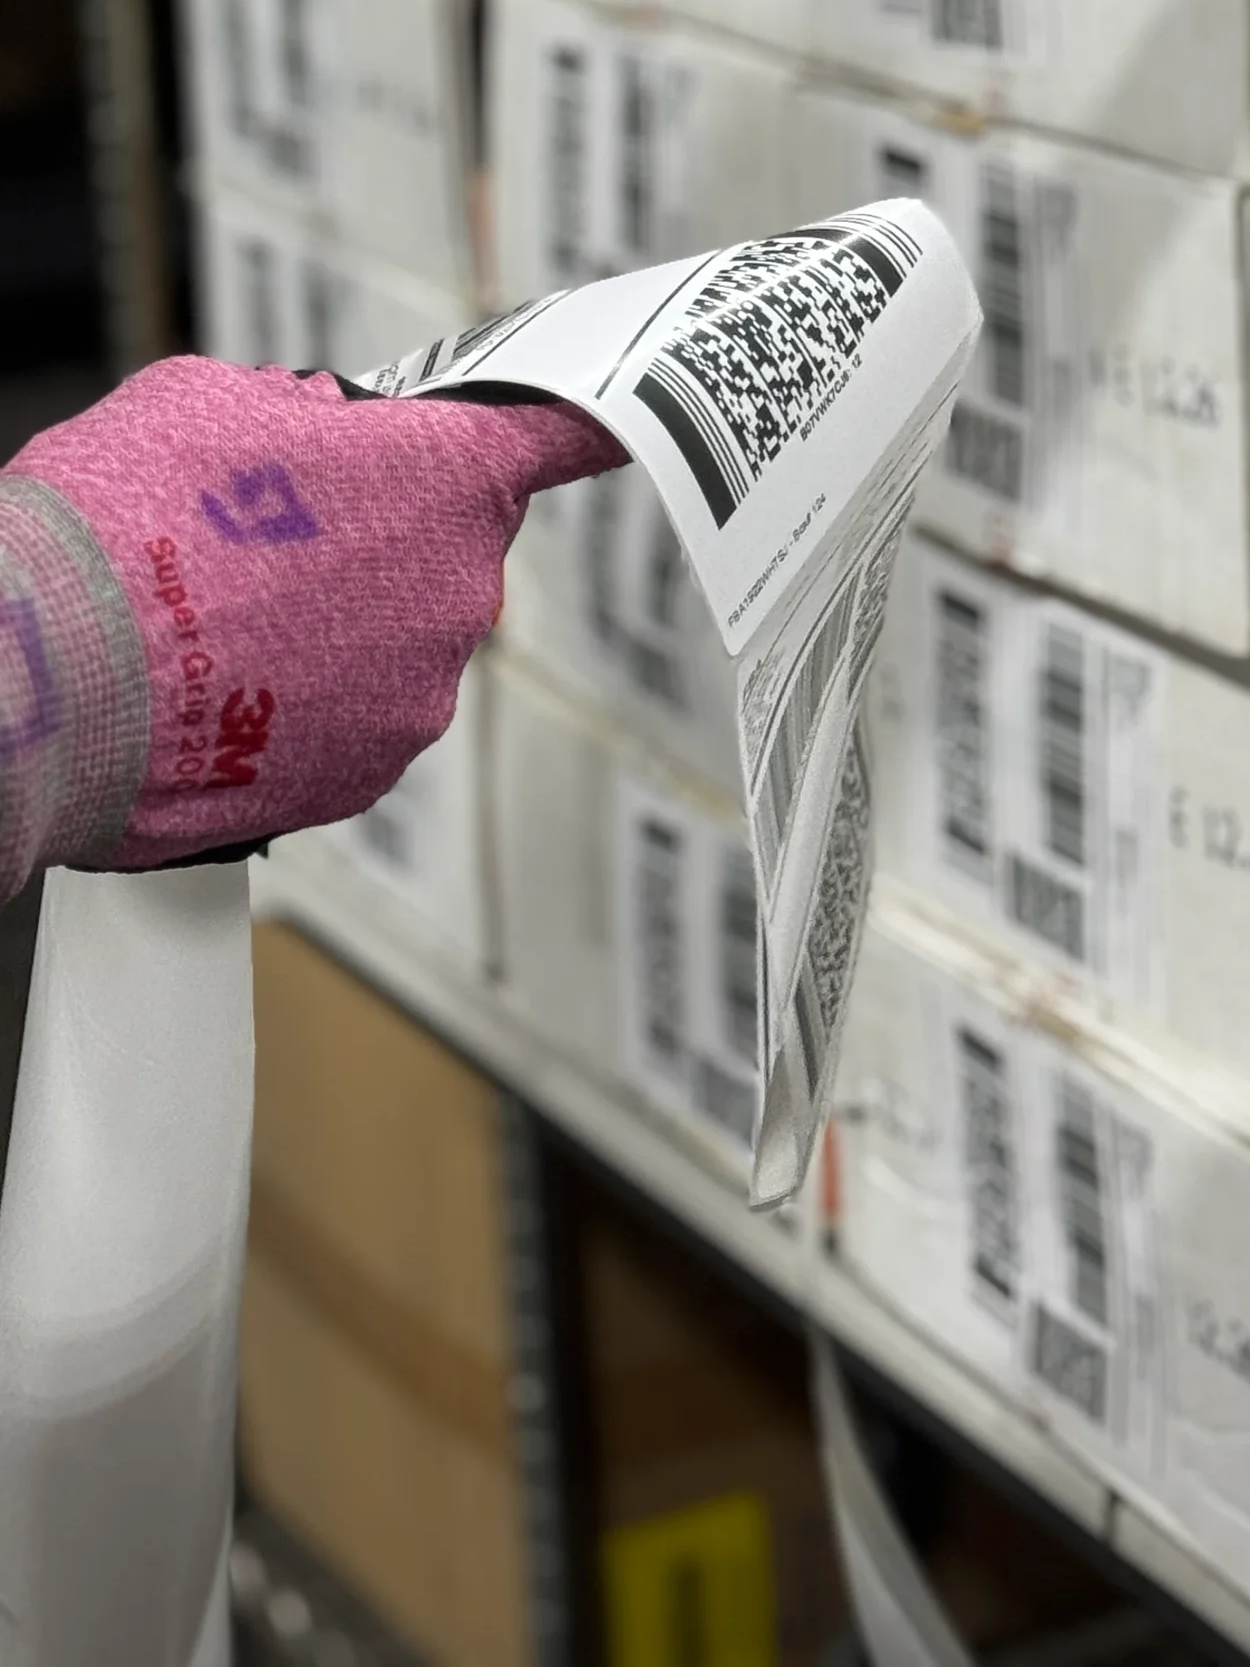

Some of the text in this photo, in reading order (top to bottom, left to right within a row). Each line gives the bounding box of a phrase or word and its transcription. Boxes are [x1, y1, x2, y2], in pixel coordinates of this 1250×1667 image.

[144, 536, 200, 639] Super
[180, 649, 215, 727] Grip
[203, 687, 276, 790] 3M
